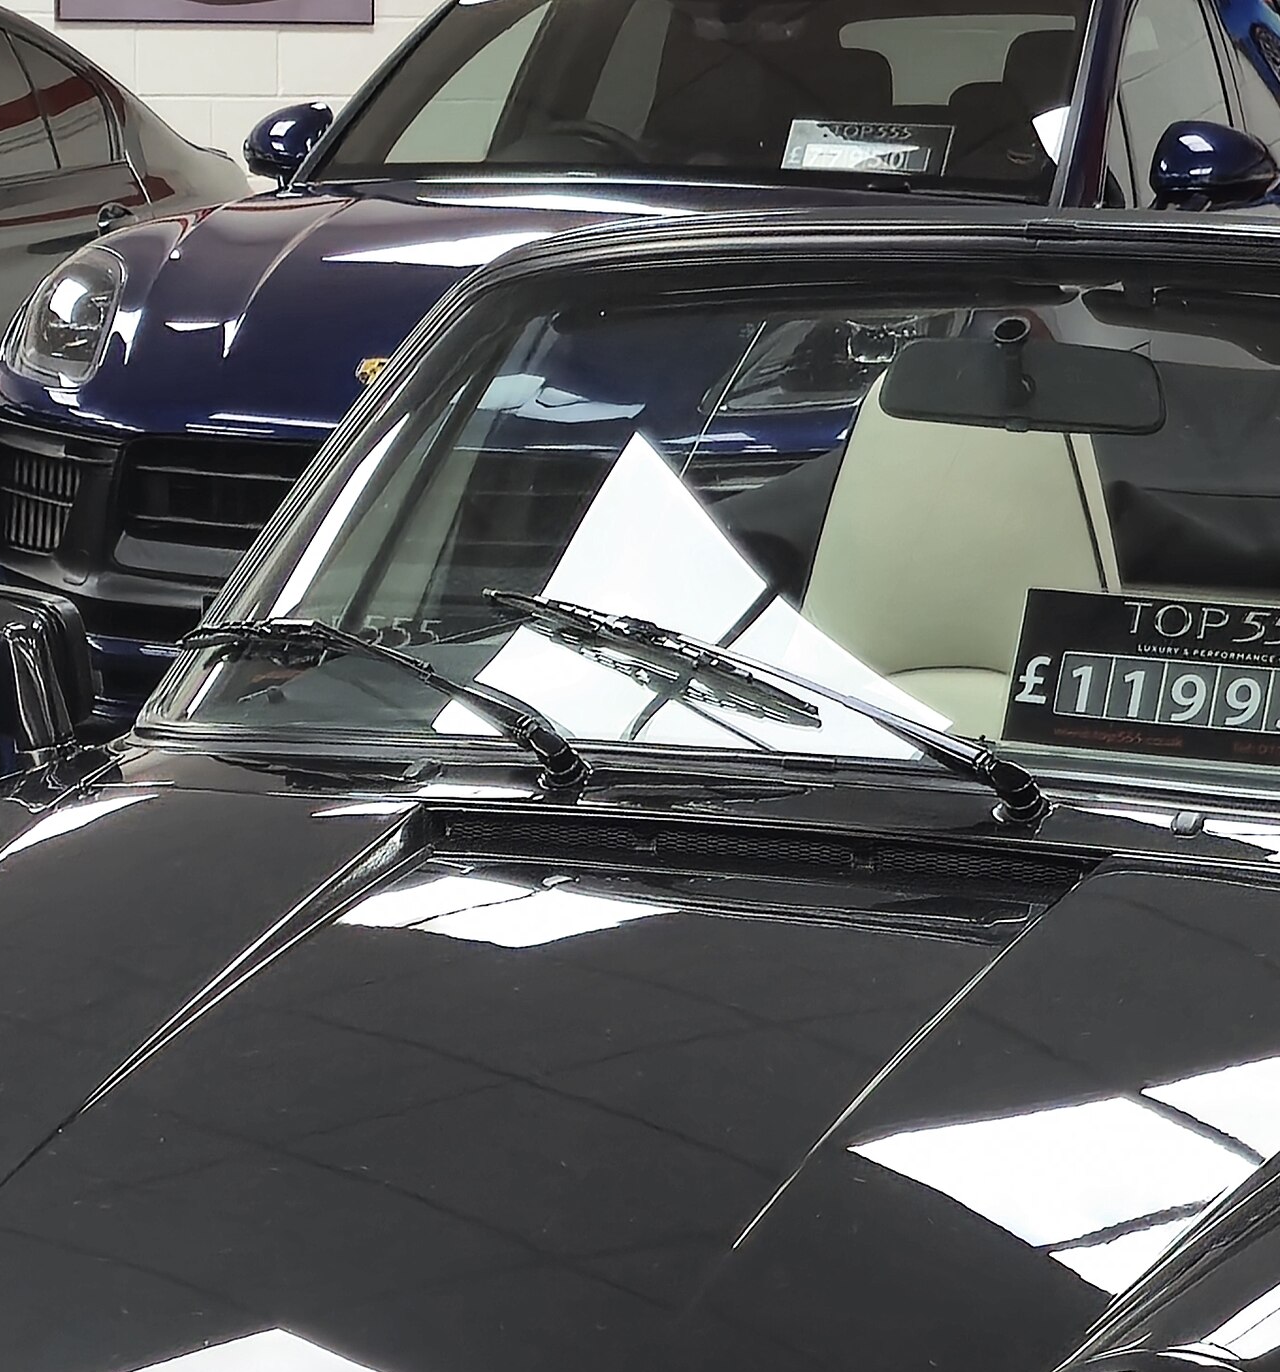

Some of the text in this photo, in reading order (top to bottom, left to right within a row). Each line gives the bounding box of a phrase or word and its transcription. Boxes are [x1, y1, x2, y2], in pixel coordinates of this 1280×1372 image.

[833, 124, 912, 140] TOP 555
[1123, 600, 1230, 640] TOP
[1137, 643, 1180, 656] LUXURY
[1192, 649, 1276, 664] PERFORMANCE
